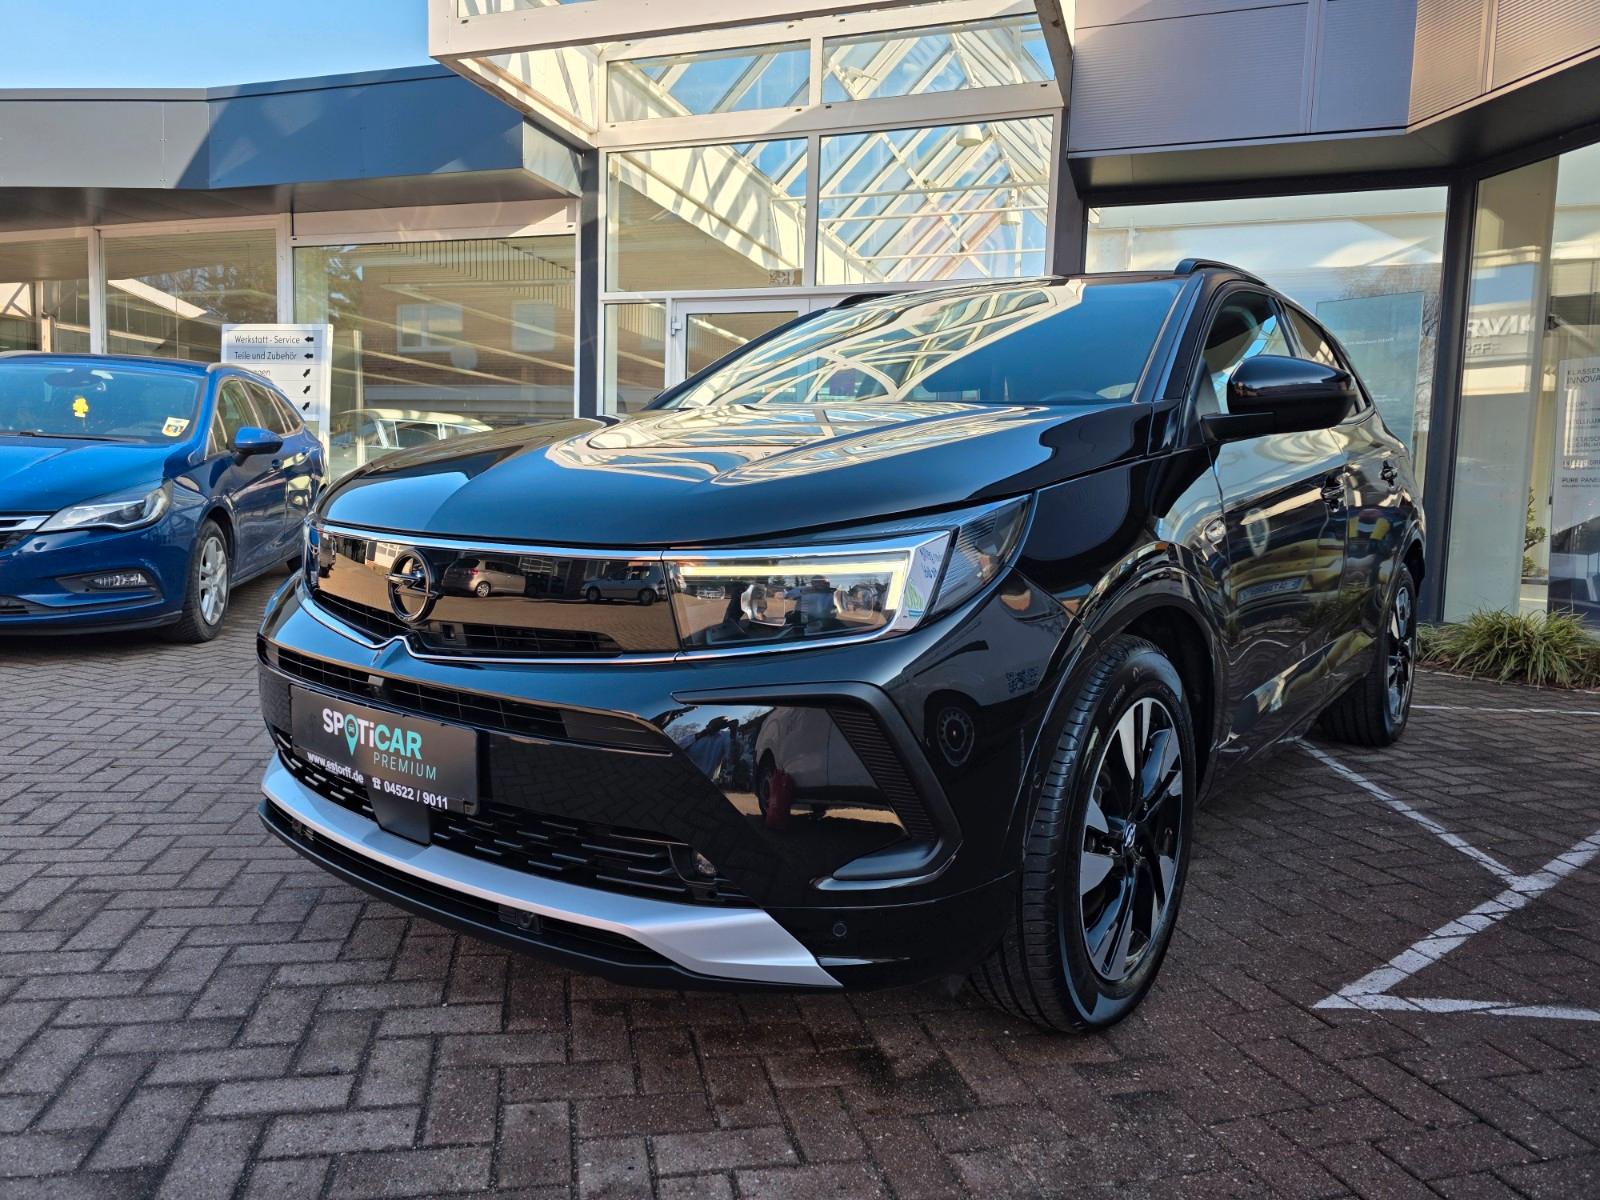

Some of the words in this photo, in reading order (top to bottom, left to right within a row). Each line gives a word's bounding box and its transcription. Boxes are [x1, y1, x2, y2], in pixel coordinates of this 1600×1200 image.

[234, 335, 268, 344] Werkstatt
[274, 335, 300, 344] Service
[234, 351, 250, 360] Teile
[251, 351, 265, 360] und
[266, 351, 296, 360] Zubehör
[373, 752, 437, 780] PREMIUM
[307, 752, 364, 784] www.estorff.de
[384, 780, 414, 801] 04522
[423, 791, 448, 810] 9011
